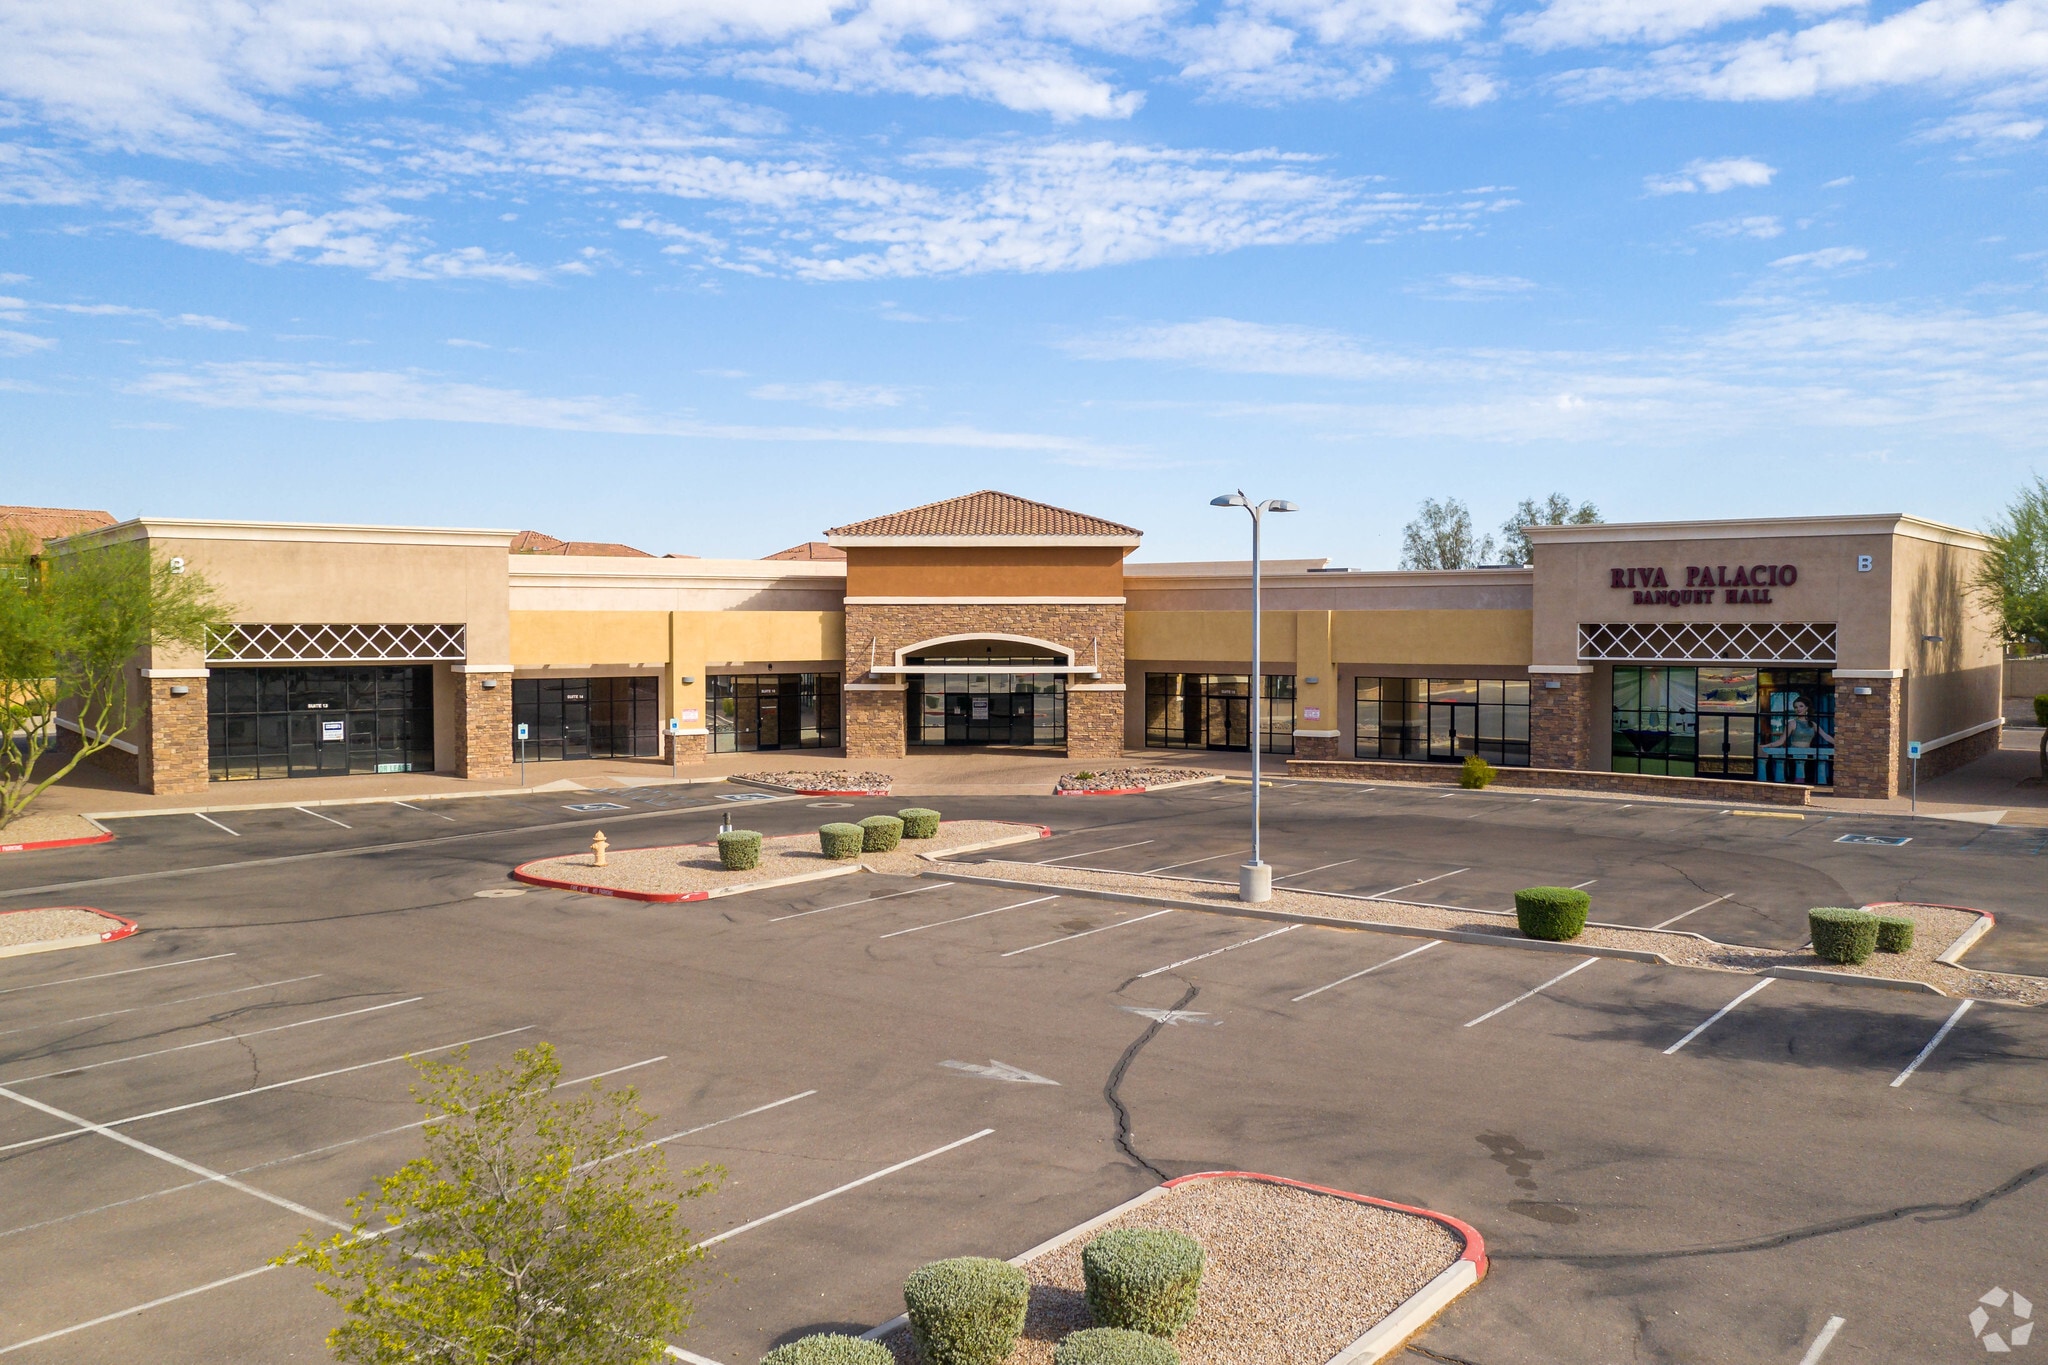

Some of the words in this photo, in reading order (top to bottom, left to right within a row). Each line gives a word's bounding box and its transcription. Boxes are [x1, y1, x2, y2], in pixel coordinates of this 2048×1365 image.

[170, 557, 185, 574] B
[1858, 554, 1873, 572] B
[1610, 567, 1669, 588] RIVA
[1686, 564, 1798, 587] PALACIO
[1633, 589, 1715, 607] BANQUET
[1725, 589, 1773, 604] HALL
